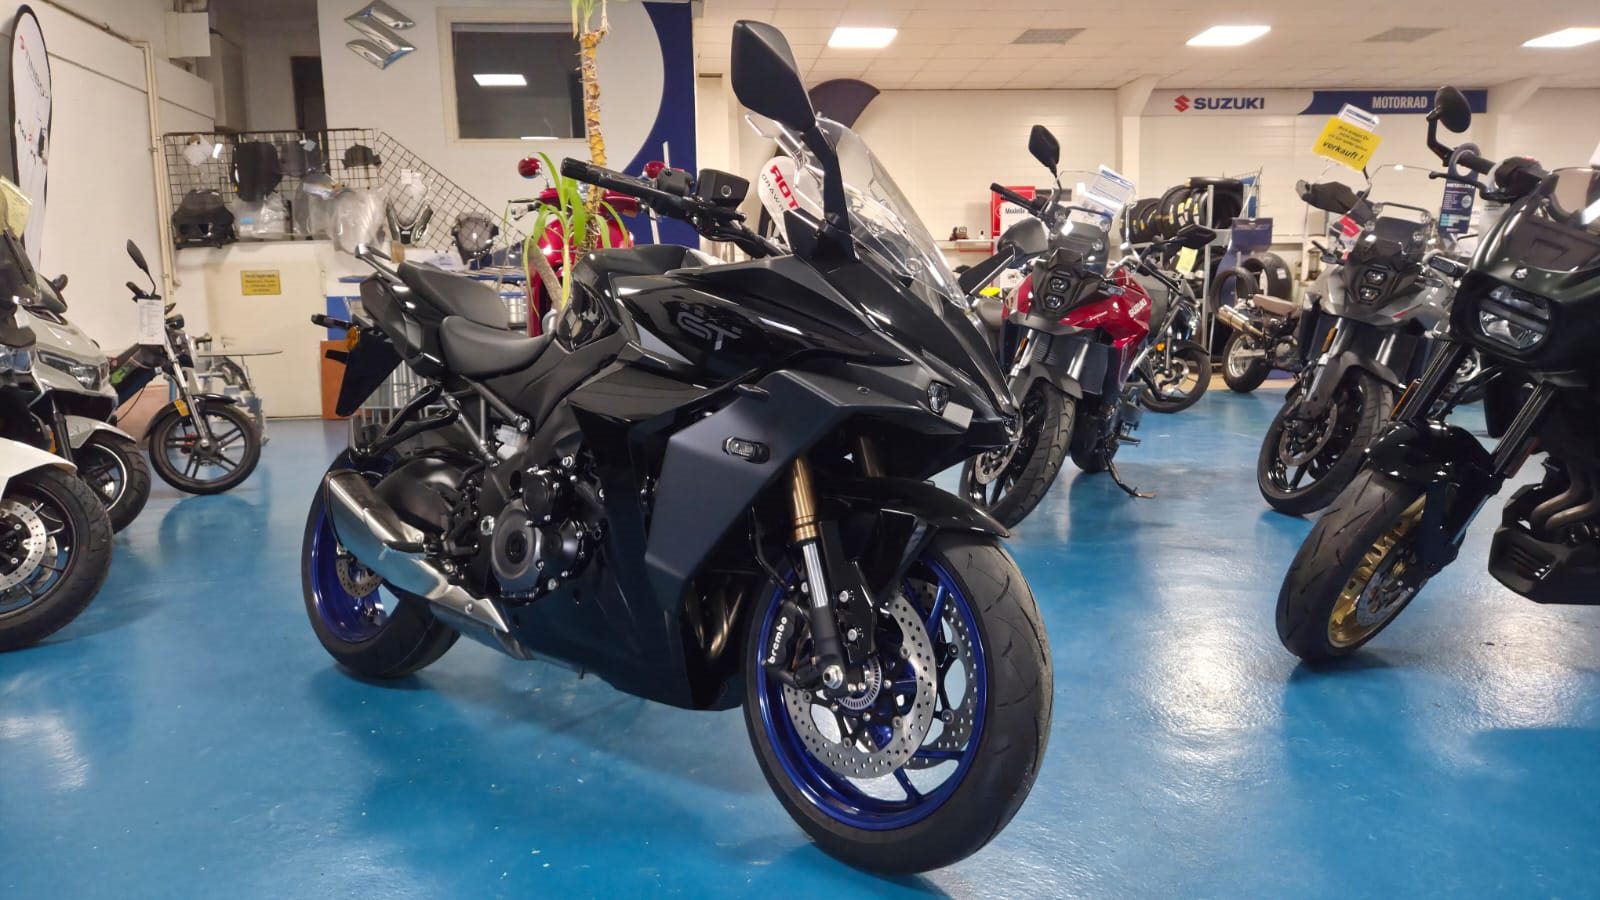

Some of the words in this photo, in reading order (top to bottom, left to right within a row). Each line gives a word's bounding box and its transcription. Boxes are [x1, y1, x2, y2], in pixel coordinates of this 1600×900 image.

[1193, 97, 1265, 110] SUZUKI
[1372, 96, 1428, 109] MOTORRAD
[1322, 141, 1359, 160] verkauft
[767, 616, 788, 665] brembo
